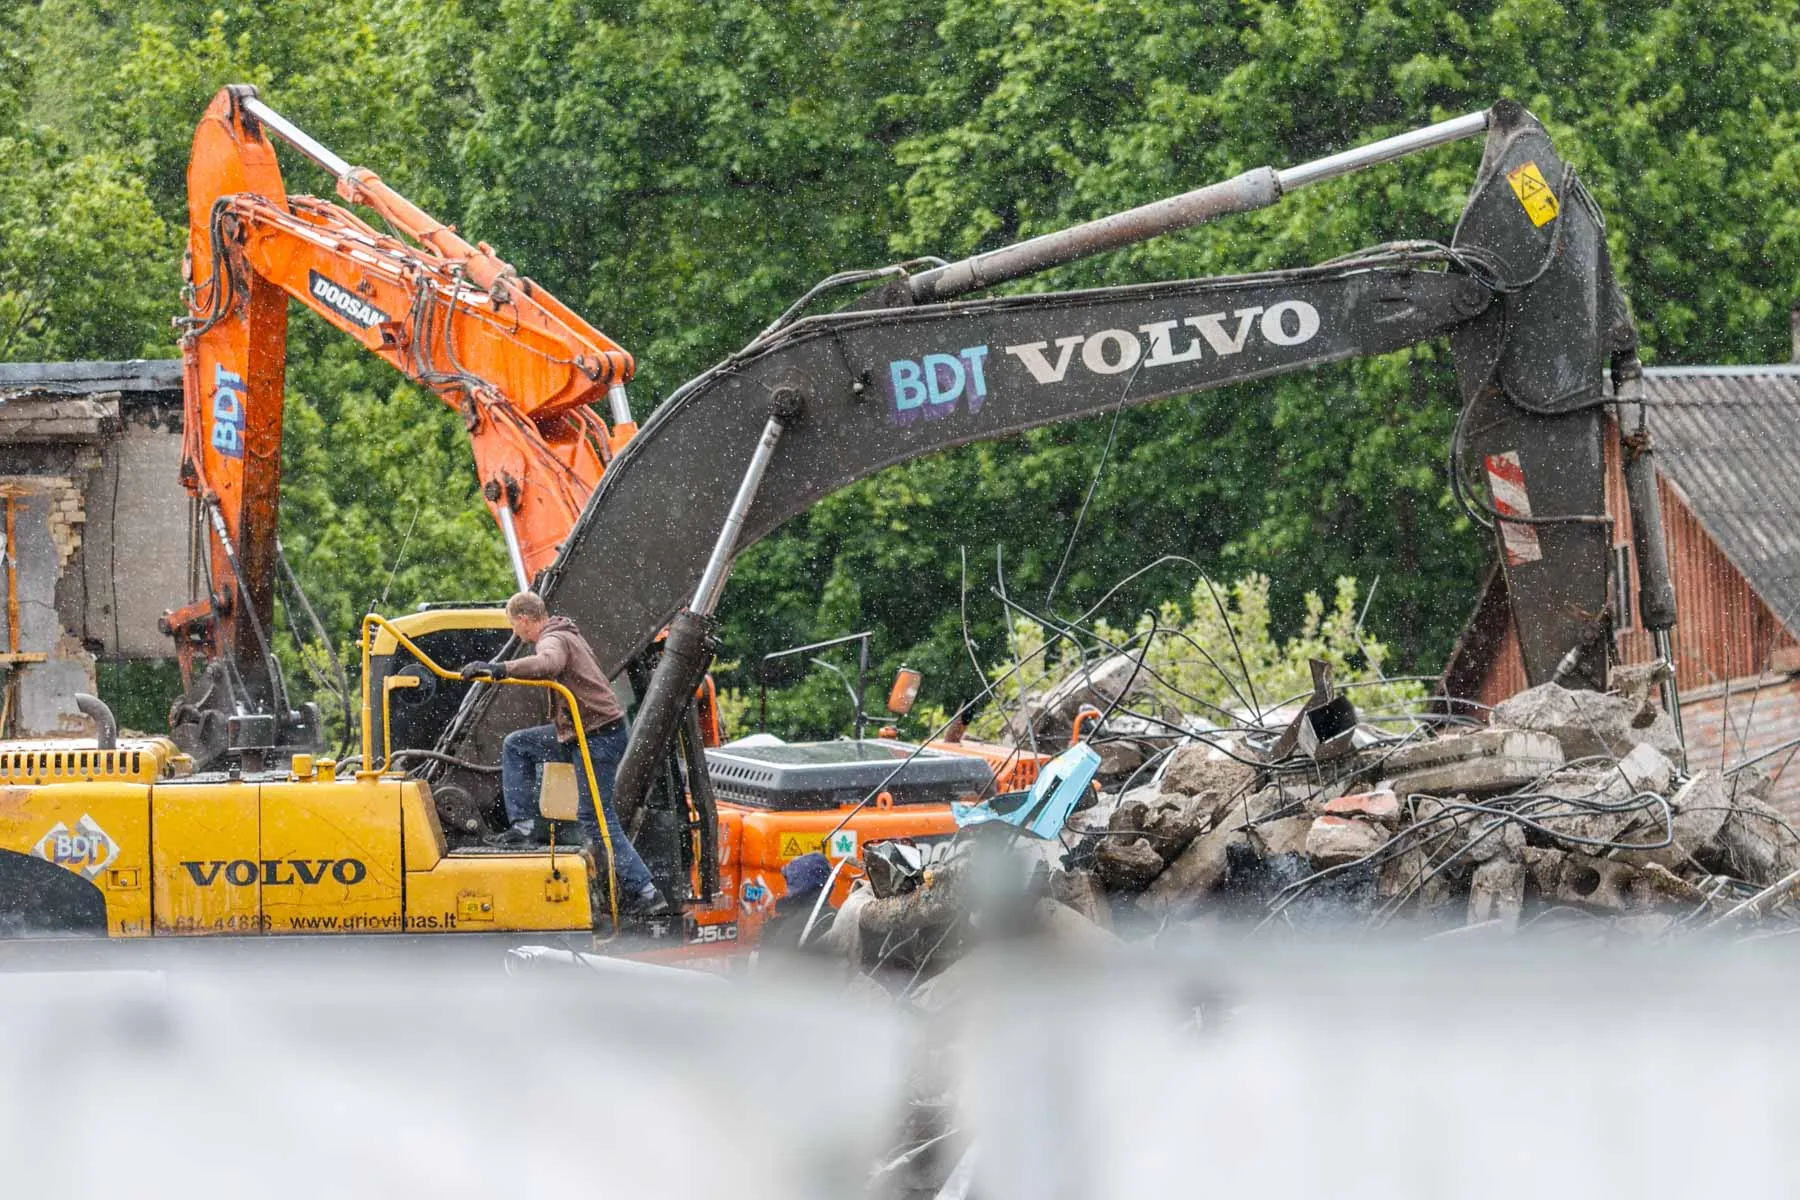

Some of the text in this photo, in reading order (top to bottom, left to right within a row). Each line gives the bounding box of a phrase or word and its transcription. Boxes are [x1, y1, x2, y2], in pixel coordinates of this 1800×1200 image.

[313, 277, 386, 326] DOOSAN
[1006, 299, 1321, 385] VOLVO
[889, 345, 988, 411] BDT
[212, 362, 241, 452] BDT
[57, 834, 102, 859] BDT
[180, 857, 367, 887] VOLVO
